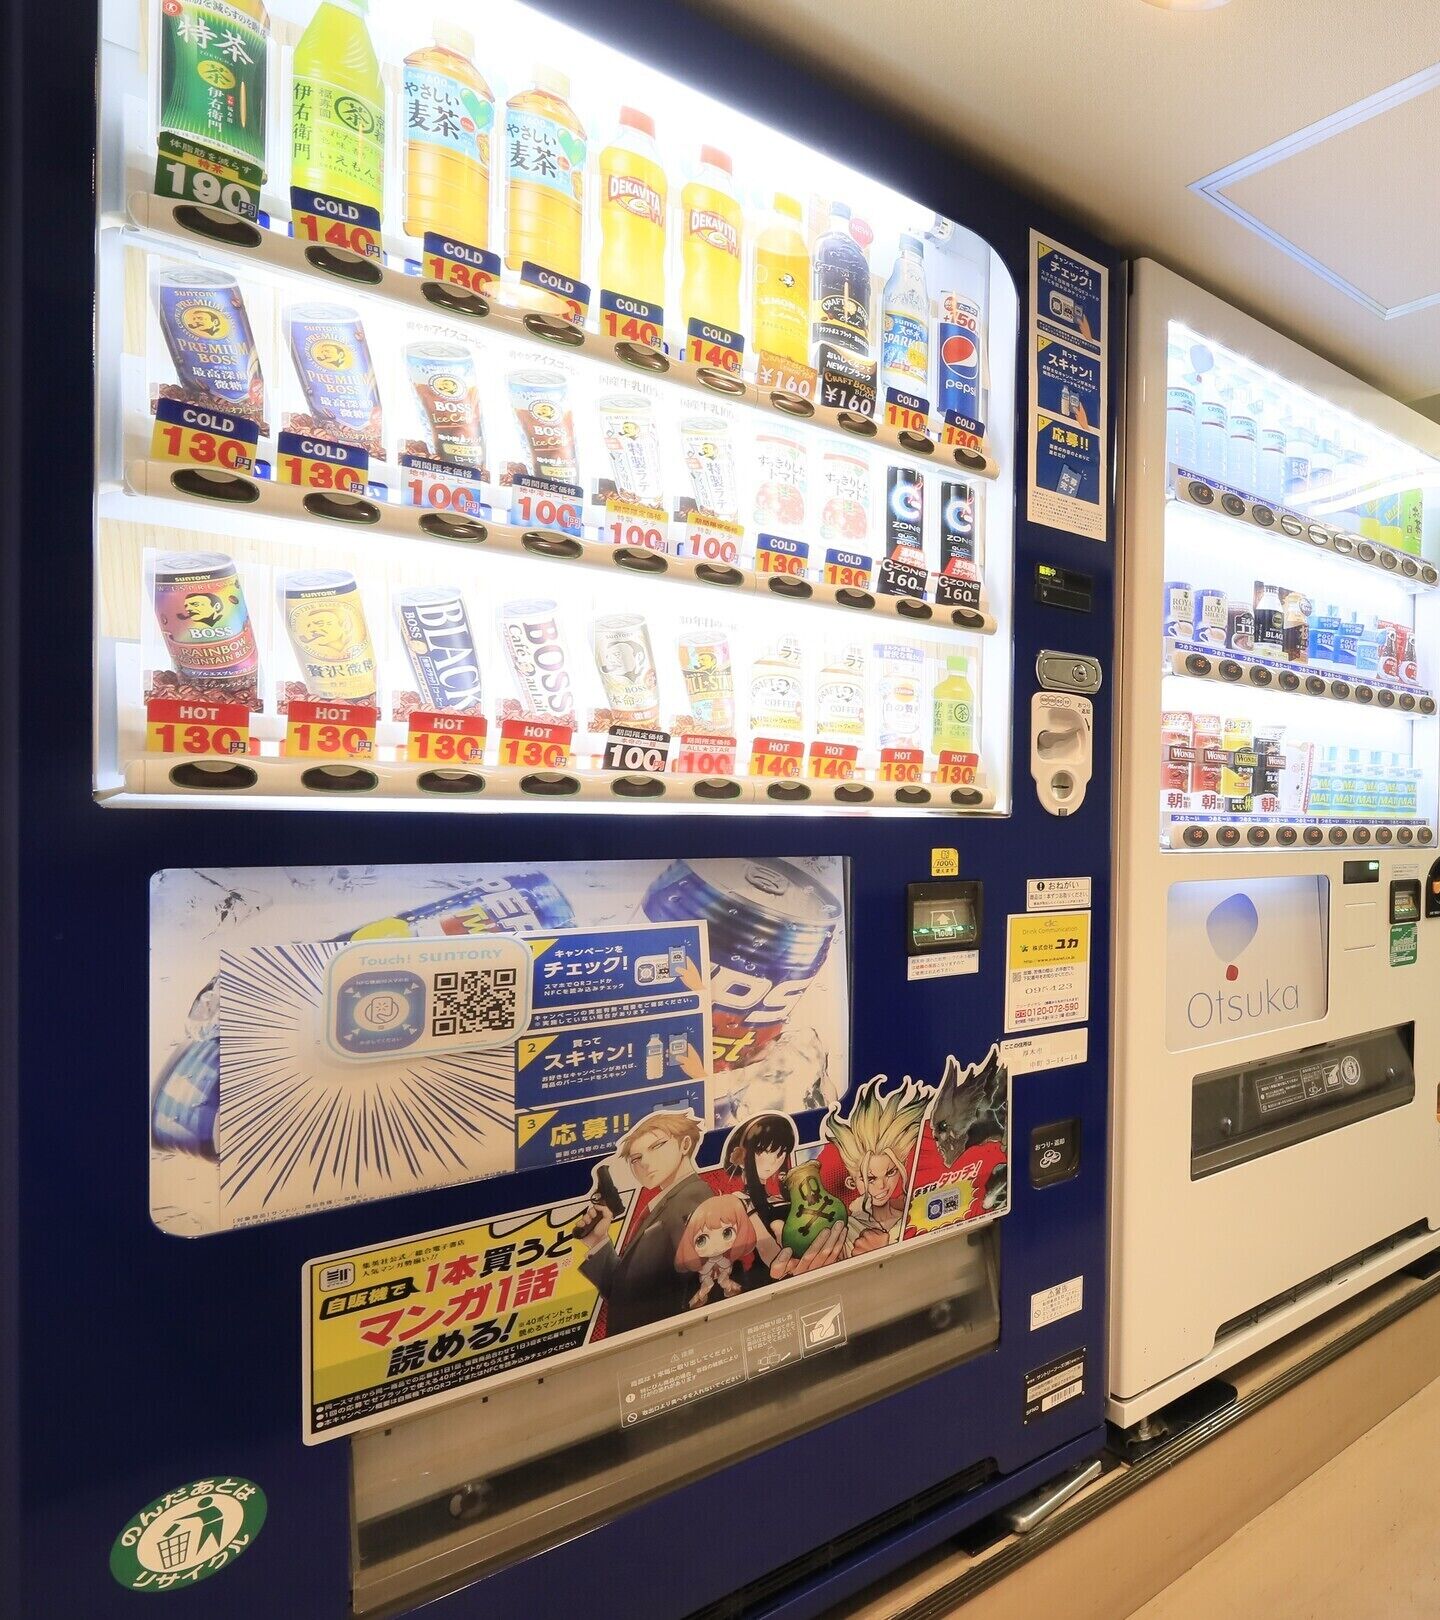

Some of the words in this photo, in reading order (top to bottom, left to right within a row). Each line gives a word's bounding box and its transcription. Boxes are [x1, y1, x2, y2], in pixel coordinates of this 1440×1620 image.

[176, 16, 254, 65] 特茶
[206, 63, 231, 85] 茶
[404, 81, 460, 106] やさしい
[207, 87, 224, 132] 伊右衛門
[342, 102, 370, 128] 茶
[293, 83, 312, 160] 伊右衛門
[407, 100, 460, 140] 麦茶
[507, 124, 556, 145] やさしい
[169, 139, 252, 173] 体脂肪を減らす
[511, 141, 557, 178] 麦茶
[314, 197, 359, 220] COLD
[443, 242, 483, 265] COLD
[1054, 254, 1090, 276] キャンペーンを
[538, 271, 574, 293] COLD
[616, 297, 648, 317] COLD
[702, 325, 731, 344] COLD
[178, 338, 249, 355] PREMIUM
[1062, 349, 1078, 360] 買って
[199, 352, 239, 365] BOSS
[307, 371, 374, 386] PREMIUM
[761, 366, 810, 397] ¥160
[326, 384, 360, 395] BOSS
[435, 401, 472, 412] BOSS
[825, 385, 871, 415] ¥160
[897, 394, 920, 408] COLD
[182, 410, 235, 433] COLD
[534, 425, 567, 436] BOSS
[955, 416, 976, 430] COLD
[301, 441, 347, 461] COLD
[411, 459, 472, 479] 期間限定価格
[521, 478, 576, 496] 期間限定価格
[770, 538, 797, 552] COLD
[837, 553, 862, 565] COLD
[175, 574, 211, 582] SUNTORY
[300, 590, 337, 598] SUNTORY
[190, 626, 234, 638] BOSS
[404, 611, 422, 639] BOSS
[181, 636, 247, 657] RAINBOW
[415, 599, 484, 710] BLACK
[523, 618, 573, 712] BOSS
[179, 707, 220, 721] HOT
[315, 708, 351, 721] HOT
[434, 718, 464, 731] HOT
[524, 725, 551, 738] HOT
[155, 723, 246, 754] 130円
[293, 725, 372, 754] 130円
[414, 733, 483, 761] 130円
[768, 742, 790, 752] HOT
[825, 746, 844, 755] HOT
[894, 752, 911, 760] HOT
[951, 754, 967, 762] HOT
[1167, 793, 1183, 809] 朝
[1202, 794, 1217, 810] 朝
[1261, 797, 1275, 812] 朝
[1048, 882, 1079, 890] おねがい
[554, 945, 624, 958] キャンペーンを
[1055, 938, 1079, 949] ユカ
[359, 954, 411, 966] Touch!
[418, 949, 503, 964] SUNTORY
[543, 955, 628, 978] チェック!
[544, 978, 612, 990] スマホでQRコードか
[544, 983, 624, 996] NFCを読み込みチェック
[1026, 1002, 1079, 1017] 0120-072-590
[1187, 978, 1299, 1029] Otsuka
[528, 1043, 536, 1053] 2
[572, 1037, 601, 1048] 買って
[1004, 1041, 1032, 1050] ここの住所は
[544, 1043, 633, 1071] スキャン!
[541, 1071, 627, 1089] 商品のバーコードをスキャン
[527, 1119, 536, 1129] 3
[550, 1113, 630, 1147] 応募!!
[914, 1182, 938, 1197] まずは
[326, 1283, 406, 1315] 自販機で
[358, 1265, 559, 1347] マンガ1話
[519, 1310, 589, 1337] 読めるマンガが対象
[386, 1312, 519, 1378] 読める!
[121, 1479, 256, 1547] のんだあとは
[133, 1534, 249, 1588] リサイクル
